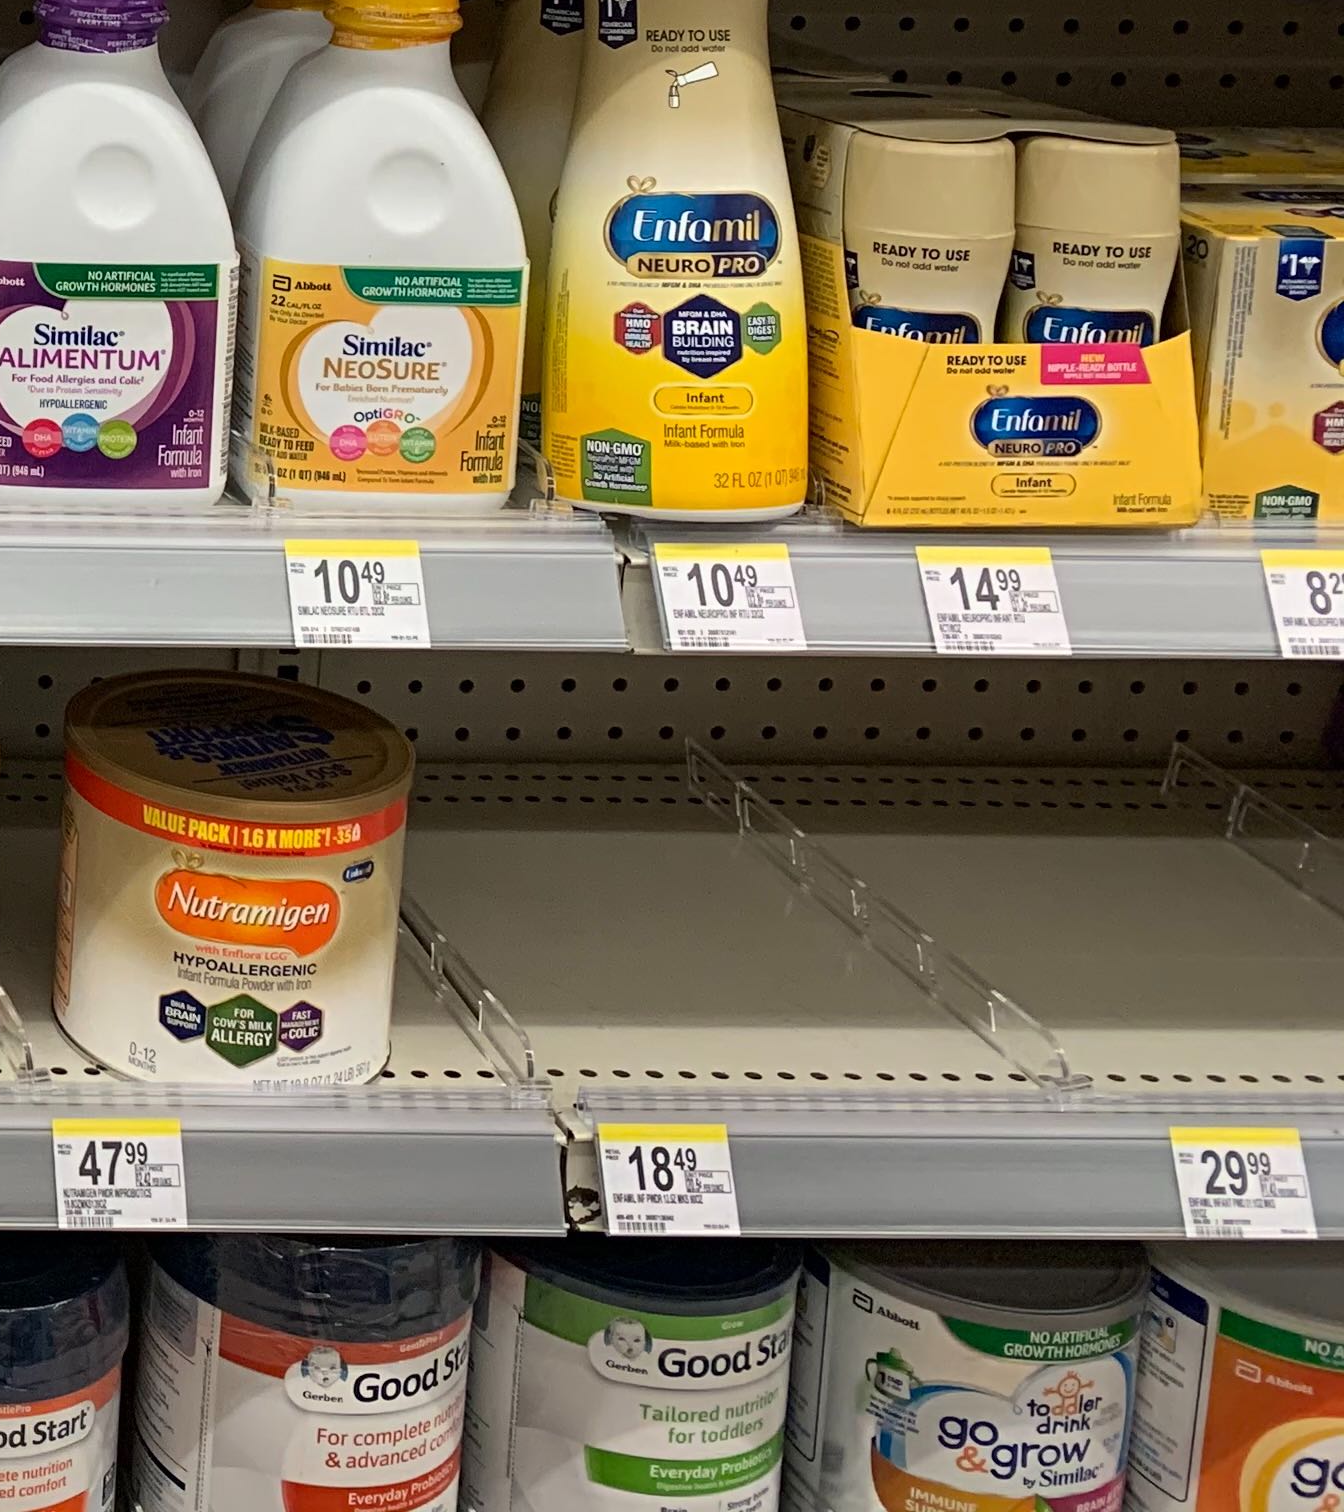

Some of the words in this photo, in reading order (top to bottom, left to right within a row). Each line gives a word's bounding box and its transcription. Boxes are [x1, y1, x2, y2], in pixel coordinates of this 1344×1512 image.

[646, 30, 682, 42] READY
[686, 30, 703, 41] TO
[707, 29, 731, 41] USE
[633, 208, 761, 246] Enfamil
[637, 257, 708, 274] NEURO
[715, 255, 762, 274] PRO
[672, 320, 733, 336] BRAIN
[39, 399, 107, 410] HYPOALLERGENIC
[143, 805, 185, 836] VALUE
[188, 817, 230, 842] PACK
[167, 883, 331, 929] Nutramigen
[173, 952, 317, 977] HYPOALLERGENIC
[212, 1030, 272, 1046] ALLERGY
[640, 1402, 719, 1426] Tailored
[1027, 1392, 1102, 1416] toddler
[1036, 1414, 1091, 1433] drink
[649, 1463, 716, 1481] Everyday
[1039, 1464, 1100, 1487] Similac
